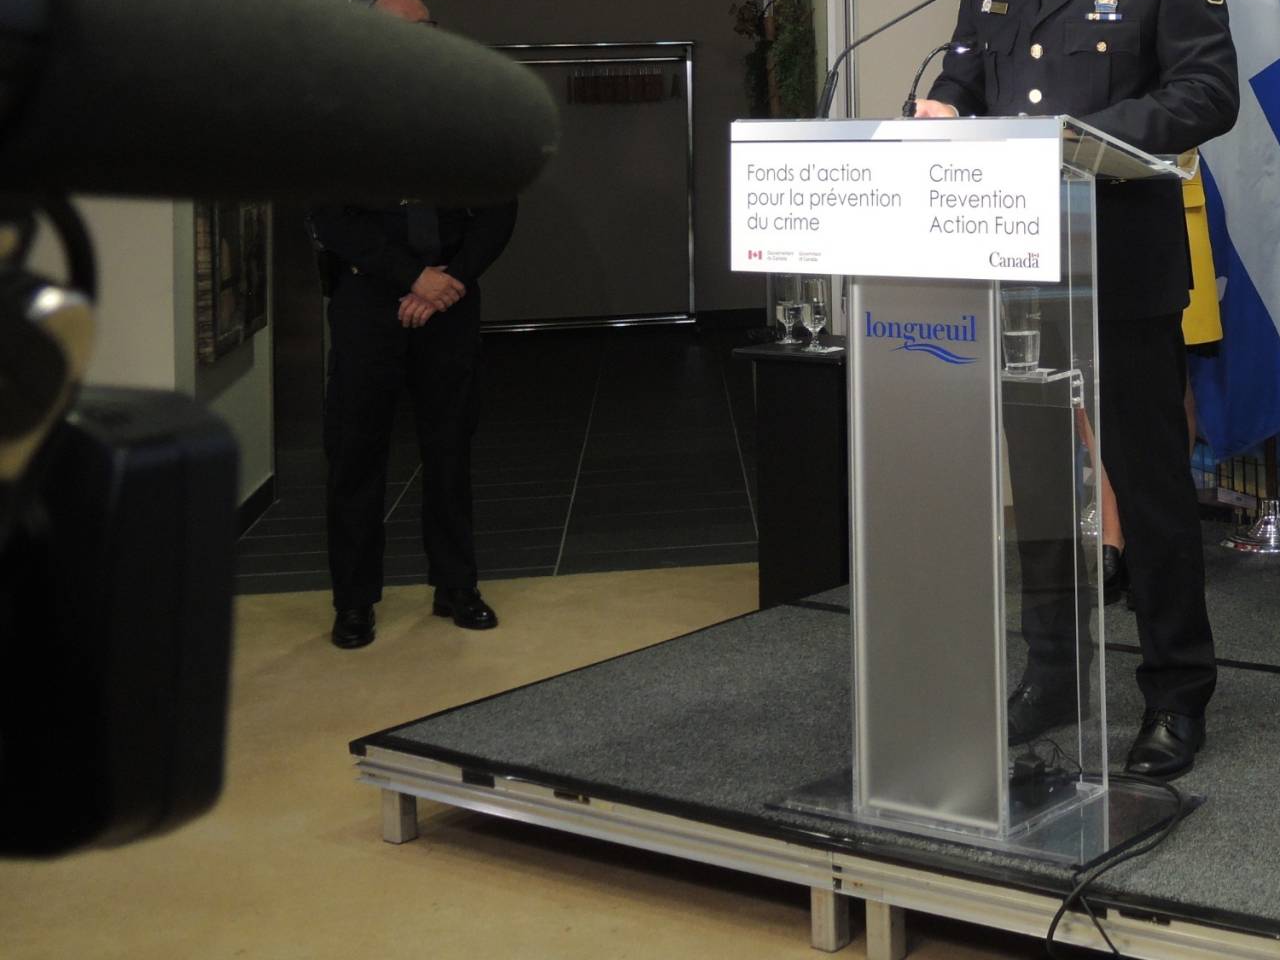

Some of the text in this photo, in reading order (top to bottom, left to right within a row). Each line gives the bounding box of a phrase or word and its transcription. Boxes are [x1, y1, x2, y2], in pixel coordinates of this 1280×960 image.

[747, 163, 872, 182] Fonds d'action
[929, 163, 983, 183] Crime
[747, 187, 902, 210] pour la prévention
[929, 189, 1026, 209] Prevention
[747, 212, 820, 231] du crime
[929, 215, 1040, 236] Action Fund
[988, 250, 1040, 269] Canada
[864, 311, 977, 347] longueuil
